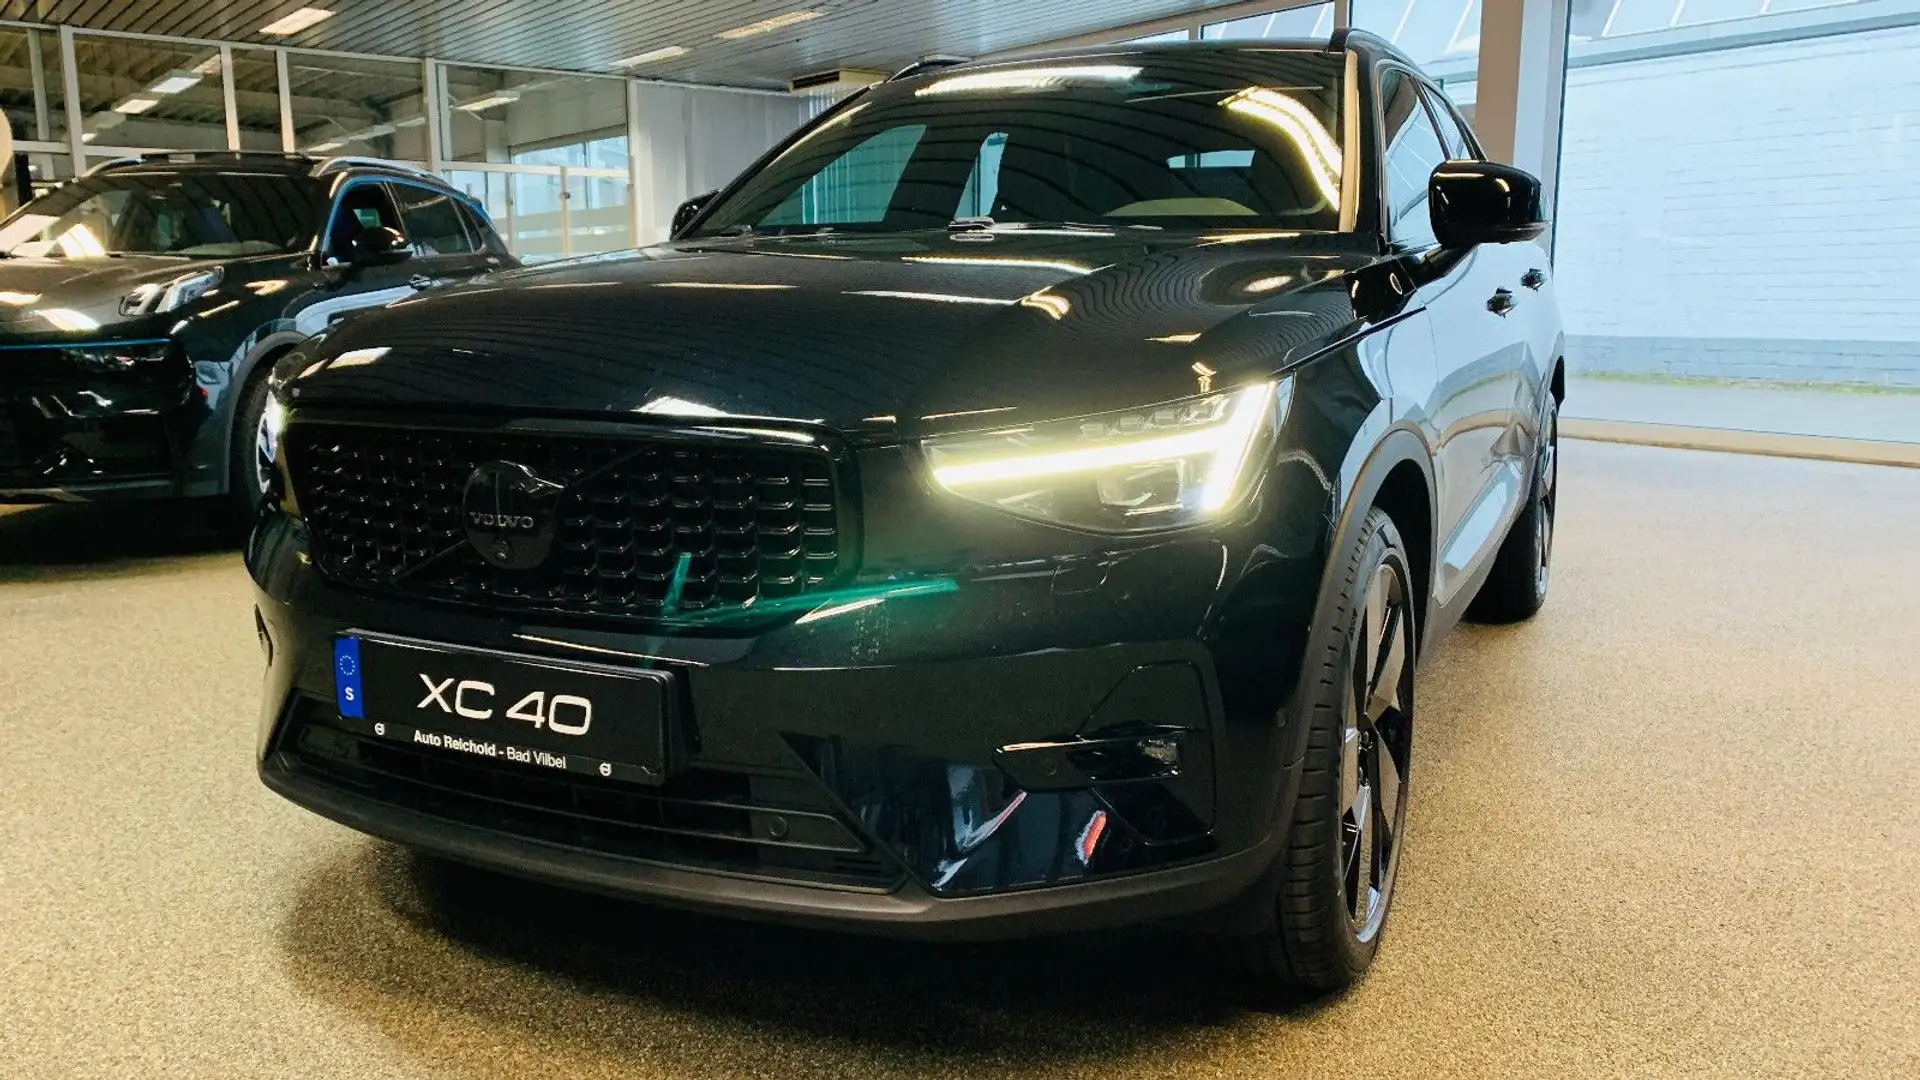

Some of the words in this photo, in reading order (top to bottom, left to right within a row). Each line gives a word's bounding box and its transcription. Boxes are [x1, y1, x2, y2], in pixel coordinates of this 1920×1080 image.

[469, 511, 534, 529] VOLVO
[344, 686, 355, 701] S
[416, 673, 495, 720] XC
[505, 691, 592, 736] 40
[413, 729, 442, 747] Auto
[443, 735, 496, 757] Reichold
[506, 746, 530, 763] Bad
[532, 751, 567, 769] Vilbel
